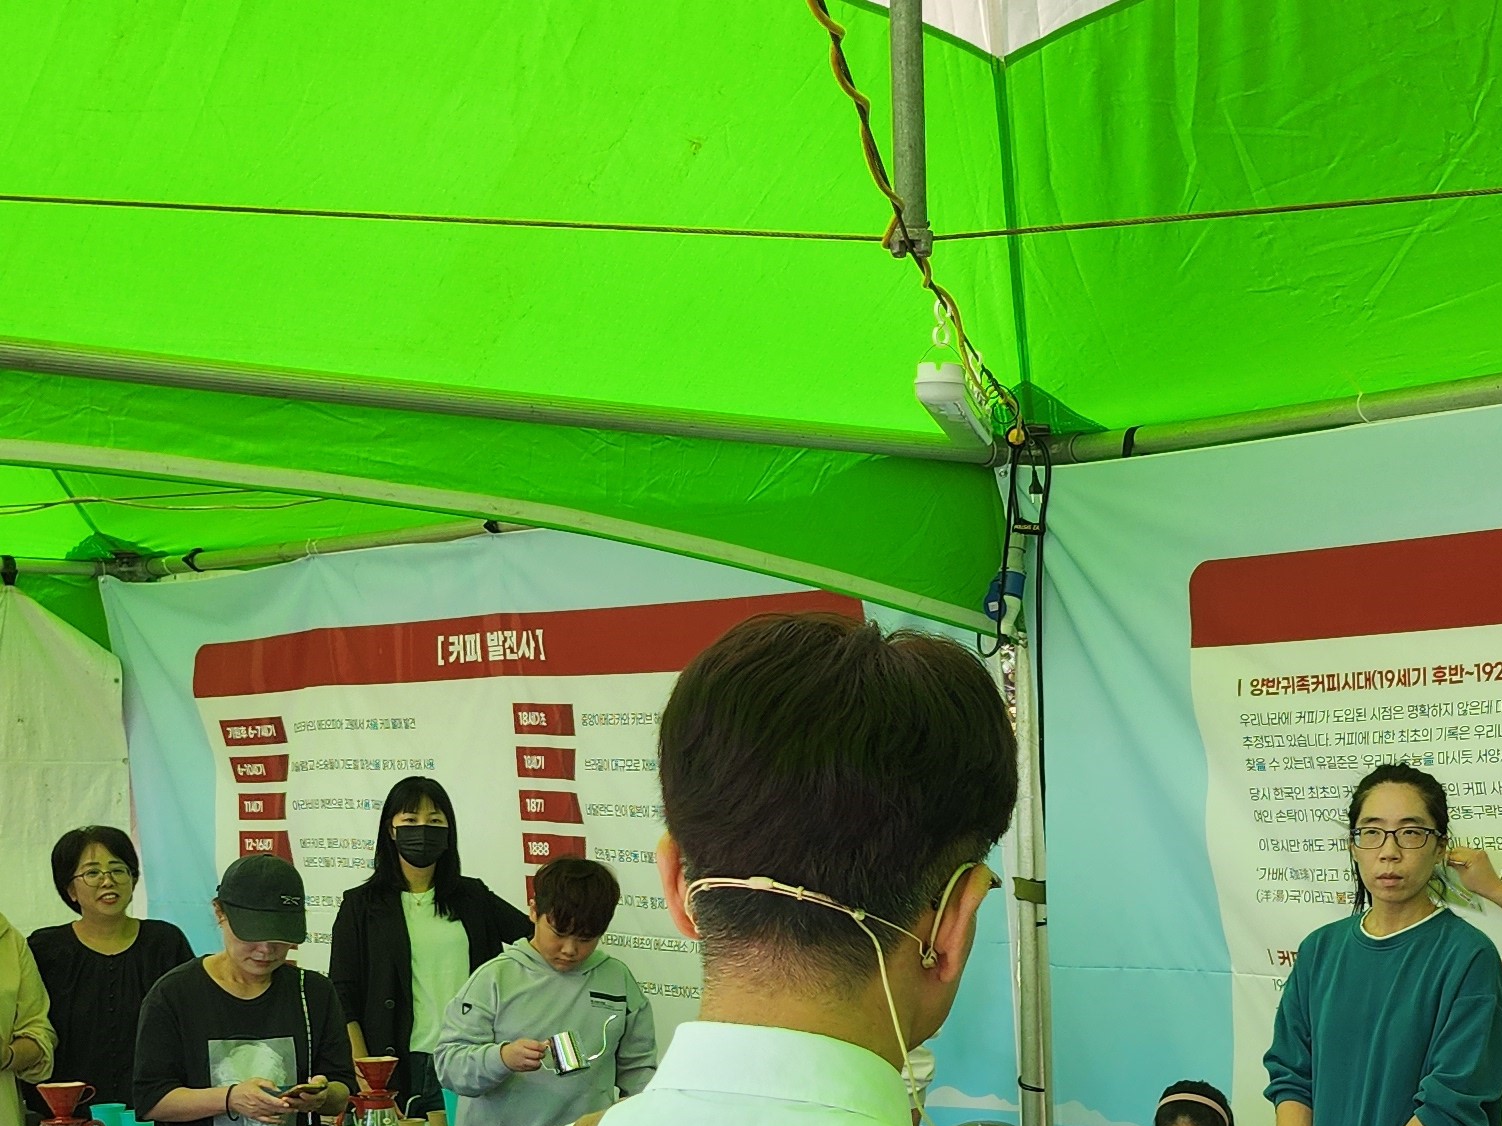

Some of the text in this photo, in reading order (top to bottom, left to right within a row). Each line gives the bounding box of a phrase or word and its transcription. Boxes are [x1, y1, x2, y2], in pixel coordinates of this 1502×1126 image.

[448, 632, 482, 663] 커피
[1249, 667, 1427, 697] 양반귀족커피시대(19세기
[1240, 711, 1292, 727] 우리나라에
[1295, 708, 1330, 726] 커피가
[1333, 707, 1367, 723] 도입된
[1370, 705, 1404, 722] 시점은
[1407, 703, 1454, 720] 명확하지
[1457, 699, 1493, 717] 않은데
[1242, 734, 1285, 750] 추정되고
[1287, 732, 1332, 748] 있습니다.
[1335, 730, 1370, 747] 커피에
[1372, 730, 1396, 745] 대한
[1398, 727, 1433, 744] 최초의
[1436, 725, 1471, 742] 기록은
[1245, 757, 1267, 772] 찾을
[1268, 756, 1280, 771] 수
[1283, 755, 1316, 771] 있는데
[1316, 755, 1359, 770] 유길준은
[1437, 749, 1473, 766] 마시듯
[1249, 787, 1271, 801] 당시
[1273, 786, 1306, 801] 한국인
[1308, 785, 1341, 800] 최초의
[1463, 781, 1487, 796] 커피
[1253, 809, 1273, 824] 여인
[1275, 808, 1307, 824] 손탁이
[1302, 838, 1326, 852] 해도
